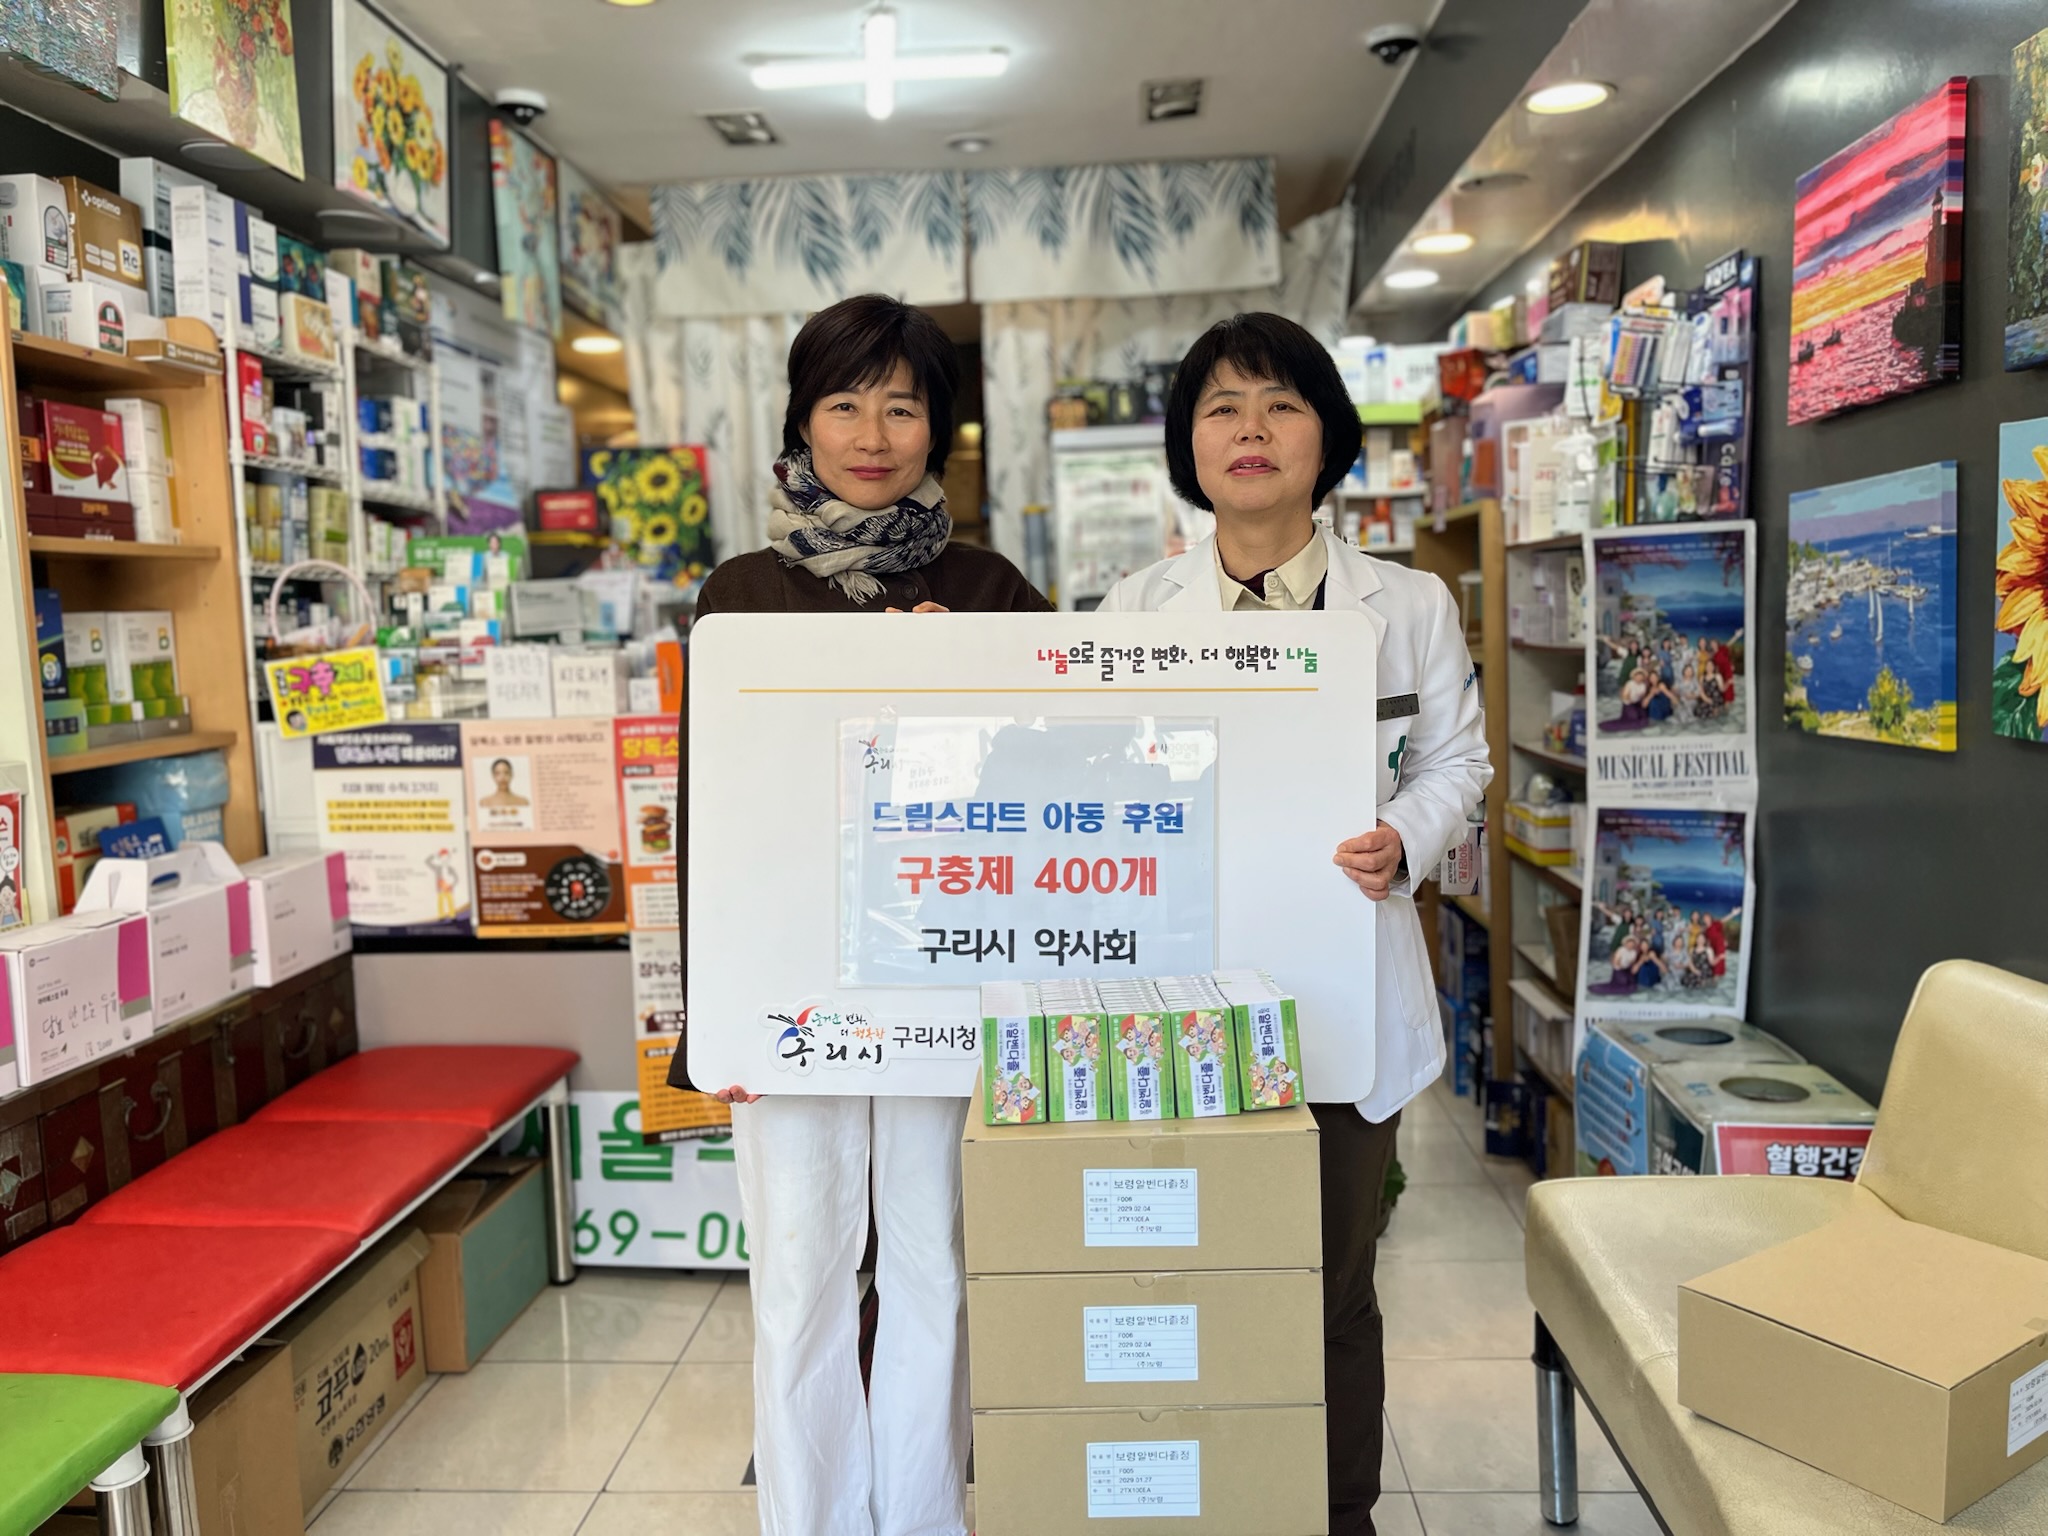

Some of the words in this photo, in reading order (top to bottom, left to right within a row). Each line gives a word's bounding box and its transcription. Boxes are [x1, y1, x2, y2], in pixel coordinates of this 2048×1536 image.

[91, 194, 121, 216] optima
[1037, 641, 1094, 675] 나눔으로
[1100, 647, 1145, 682] 즐거운
[1200, 648, 1218, 661] 더
[1225, 644, 1280, 673] 행복한
[1286, 647, 1318, 674] 나눔
[1597, 753, 1668, 781] MUSICAL
[1674, 750, 1750, 778] FESTIVAL
[872, 802, 1028, 833] 드림스타트
[1043, 802, 1105, 833] 아동
[1122, 802, 1184, 834] 후원
[897, 855, 1014, 895] 구충제
[1034, 857, 1157, 896] 400개
[918, 929, 1015, 964] 구리시
[1034, 929, 1136, 966] 약사회
[892, 1025, 977, 1051] 구리시청
[1007, 1028, 1020, 1071] 알벤다졸
[1259, 1014, 1275, 1056] 알벤다졸
[1074, 1067, 1087, 1110] 알벤다졸
[1137, 1066, 1151, 1109] 알벤다졸
[1201, 1063, 1216, 1105] 알벤다졸
